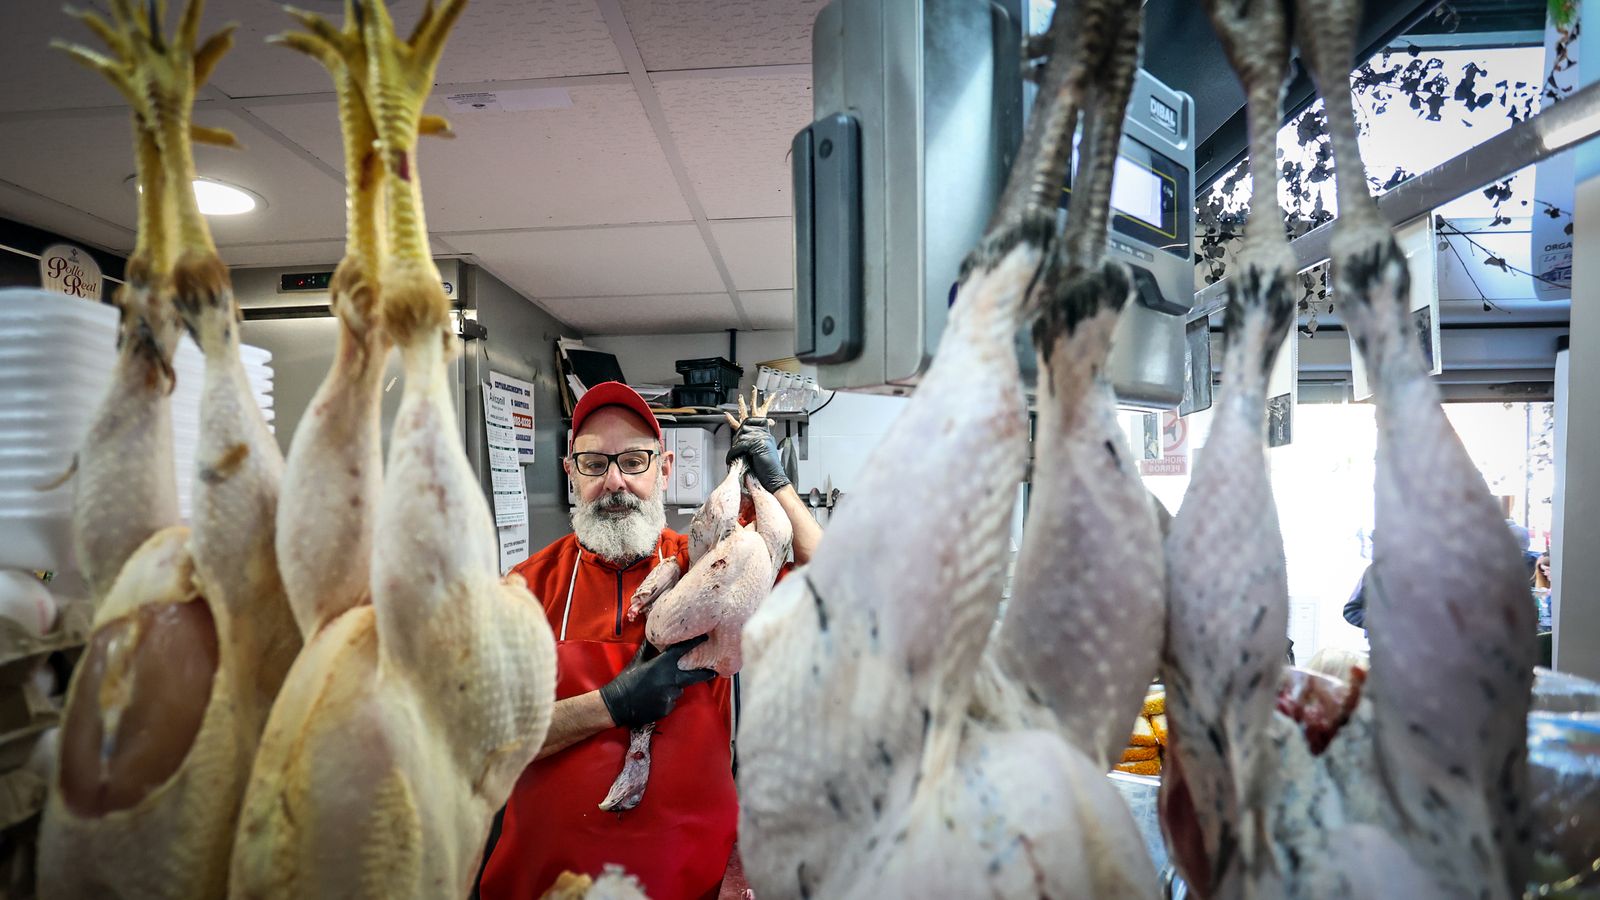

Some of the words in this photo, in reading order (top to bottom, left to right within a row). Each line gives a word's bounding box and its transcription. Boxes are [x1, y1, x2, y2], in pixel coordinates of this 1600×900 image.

[1150, 98, 1176, 127] DIBAL
[48, 257, 84, 278] Pollo
[63, 274, 96, 298] Real
